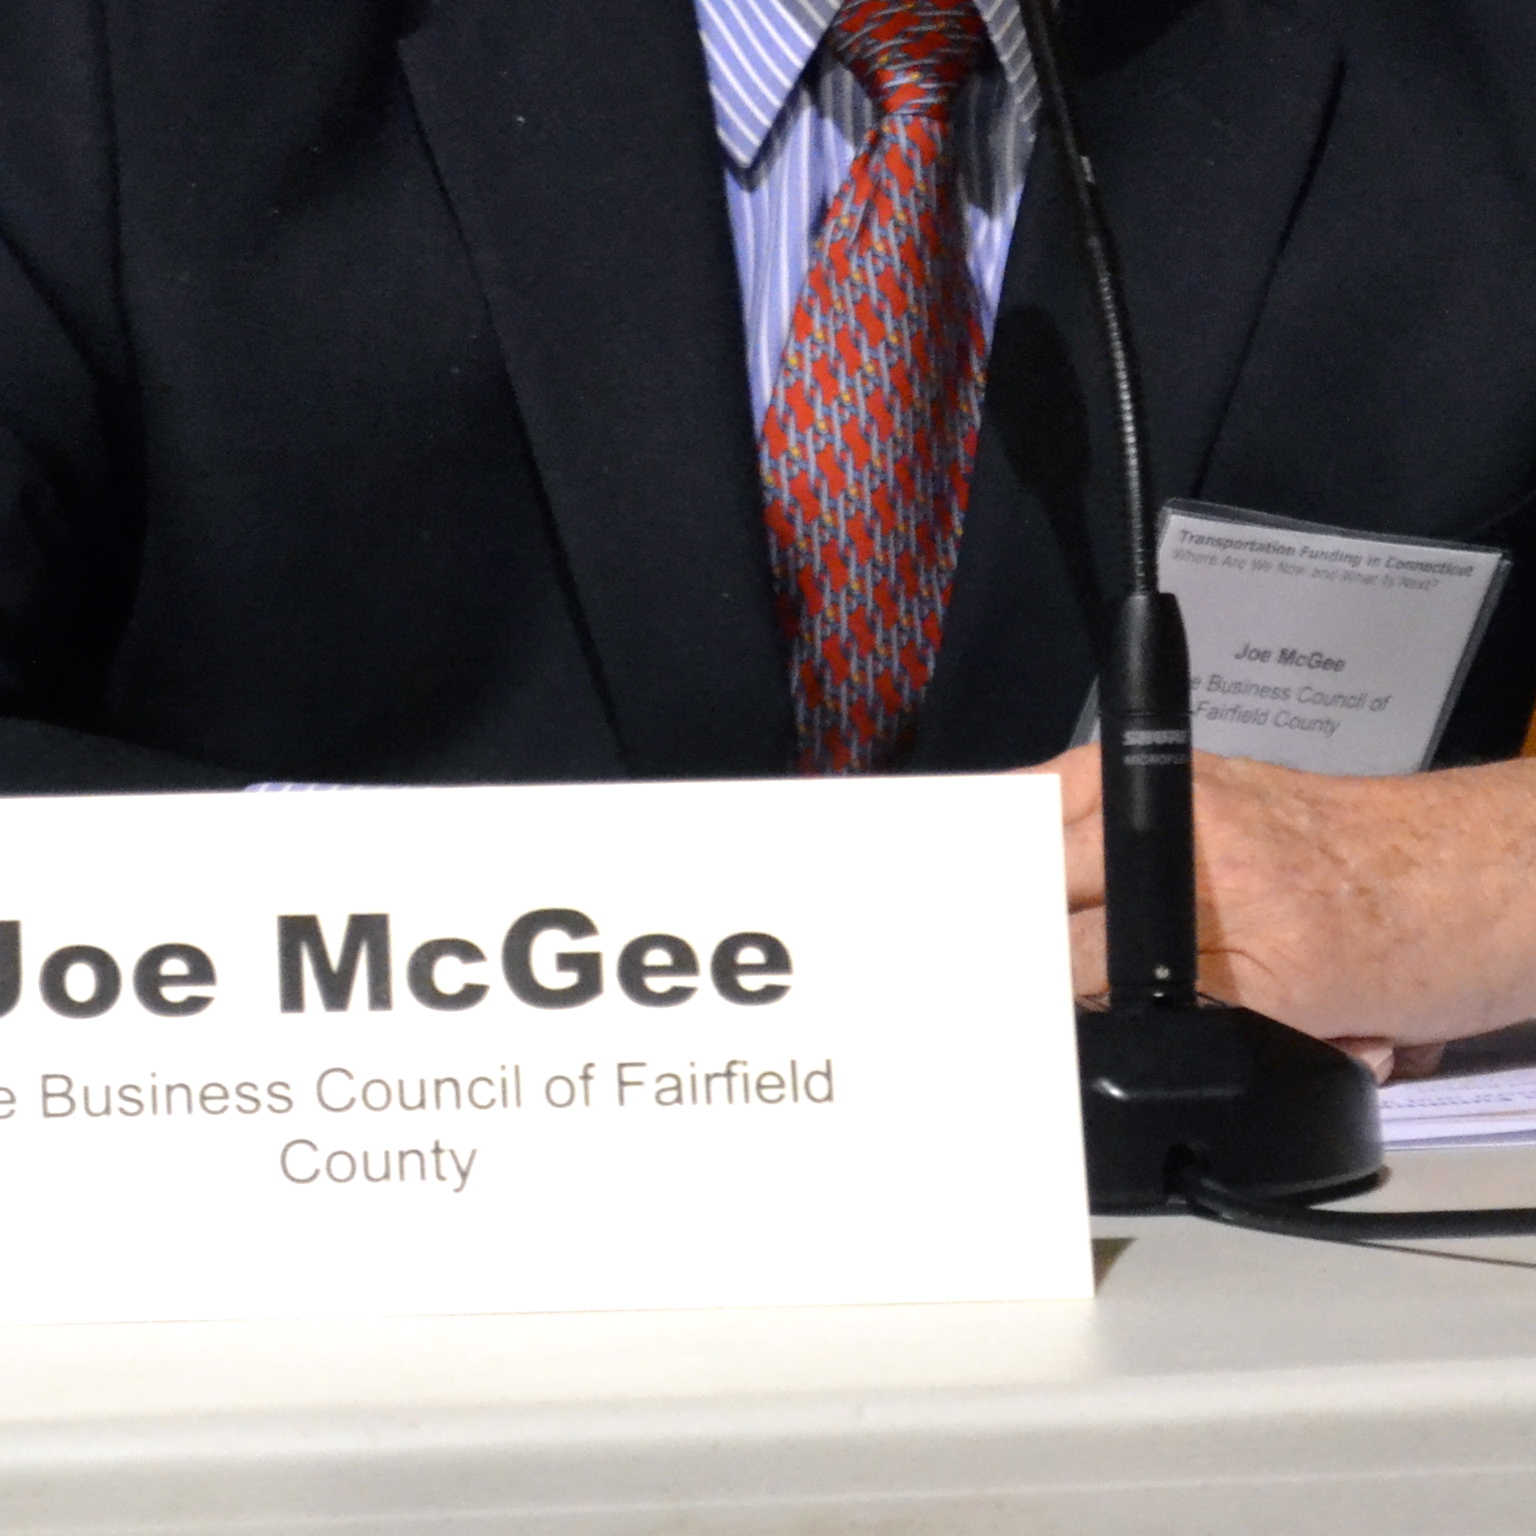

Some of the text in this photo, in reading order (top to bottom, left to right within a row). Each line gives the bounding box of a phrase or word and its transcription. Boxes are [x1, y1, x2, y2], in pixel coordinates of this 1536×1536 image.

[1172, 548, 1218, 563] Where
[1222, 555, 1245, 570] Are
[1251, 559, 1272, 573] We
[1180, 529, 1296, 557] Transportation
[1300, 545, 1363, 568] Funding
[1367, 554, 1382, 568] in
[1233, 642, 1346, 672] Joe McGee
[1205, 673, 1292, 702] Business
[1297, 685, 1368, 711] Council
[1369, 694, 1393, 713] of
[1195, 700, 1342, 739] Fairfield County
[276, 906, 794, 1015] McGee
[40, 1072, 293, 1119] Business
[315, 1064, 522, 1114] Council
[544, 1061, 596, 1109] of
[616, 1058, 834, 1107] Fairfield
[279, 1137, 477, 1194] County
